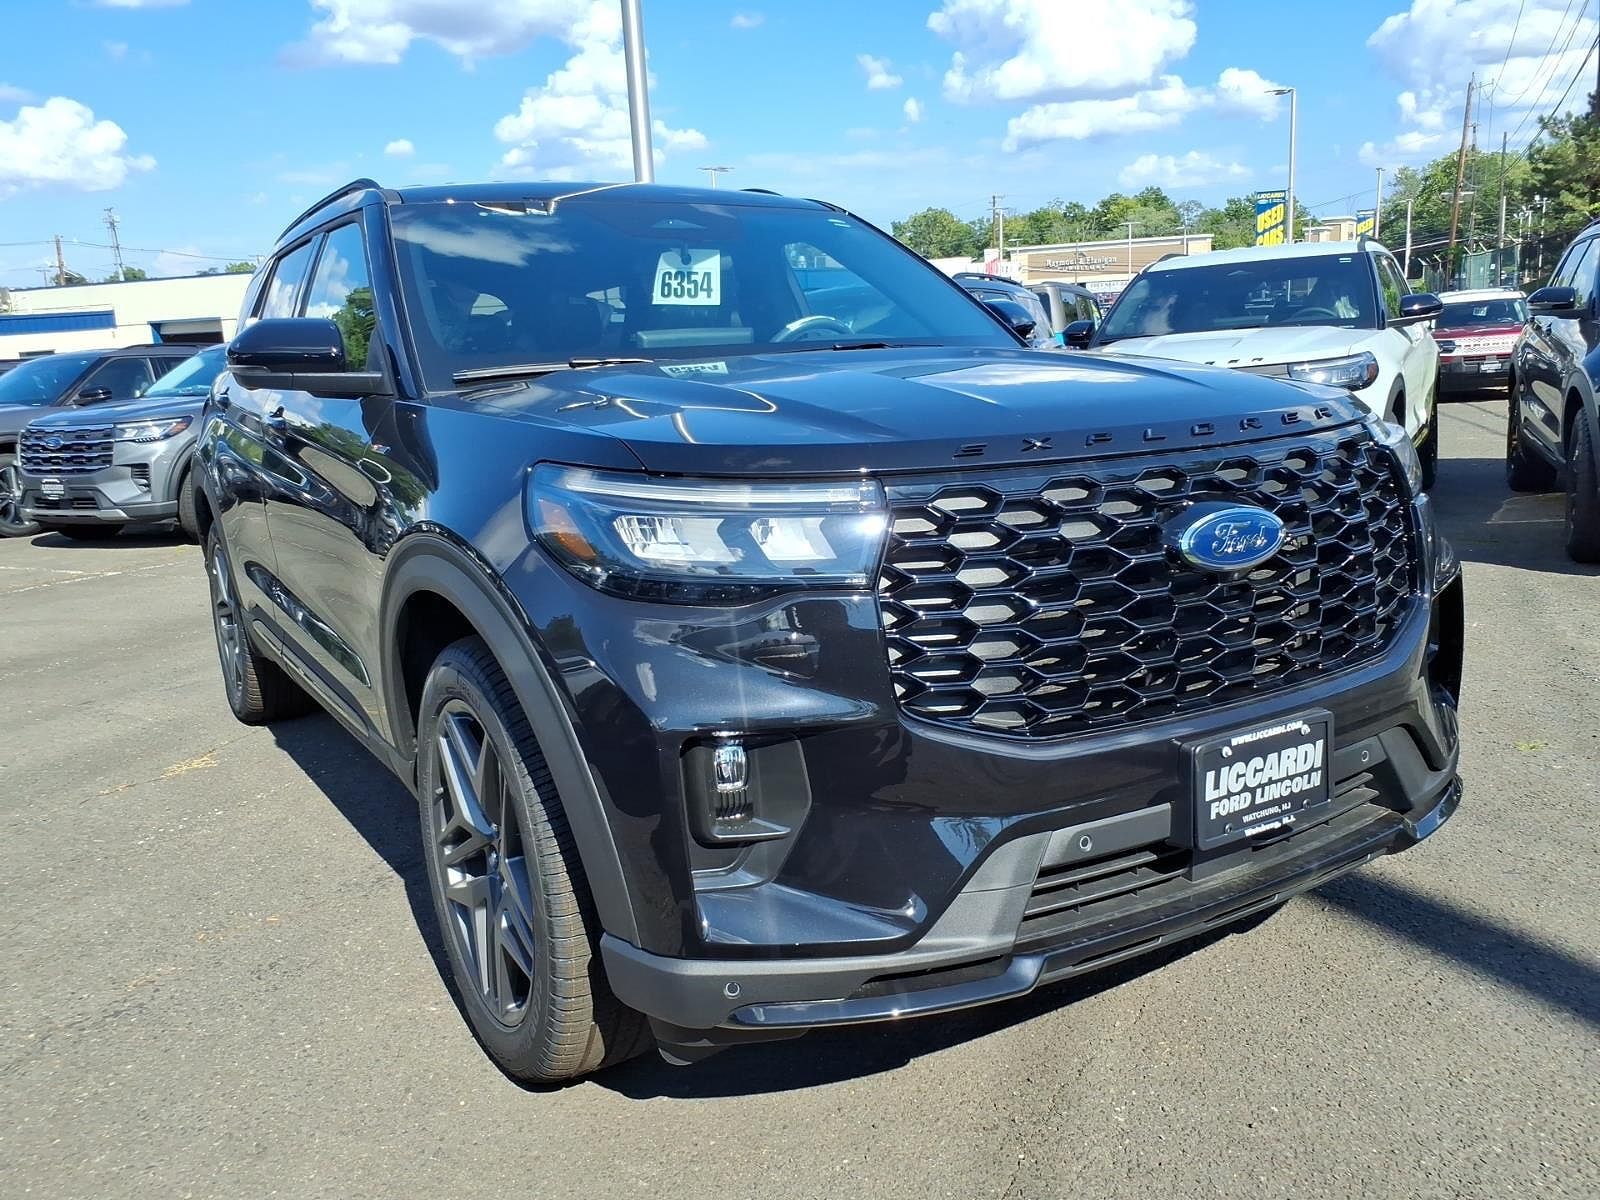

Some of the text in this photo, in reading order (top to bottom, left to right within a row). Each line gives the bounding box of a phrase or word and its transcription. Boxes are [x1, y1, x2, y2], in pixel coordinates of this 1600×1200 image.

[1256, 203, 1284, 233] USED
[1256, 225, 1284, 247] CARS
[660, 271, 713, 299] 6354
[953, 406, 1334, 458] EXPLORER
[1212, 520, 1267, 557] Ford
[1205, 739, 1324, 802] LICCARDI
[1210, 770, 1322, 820] FORD LINCOLN
[1282, 802, 1291, 811] NJ
